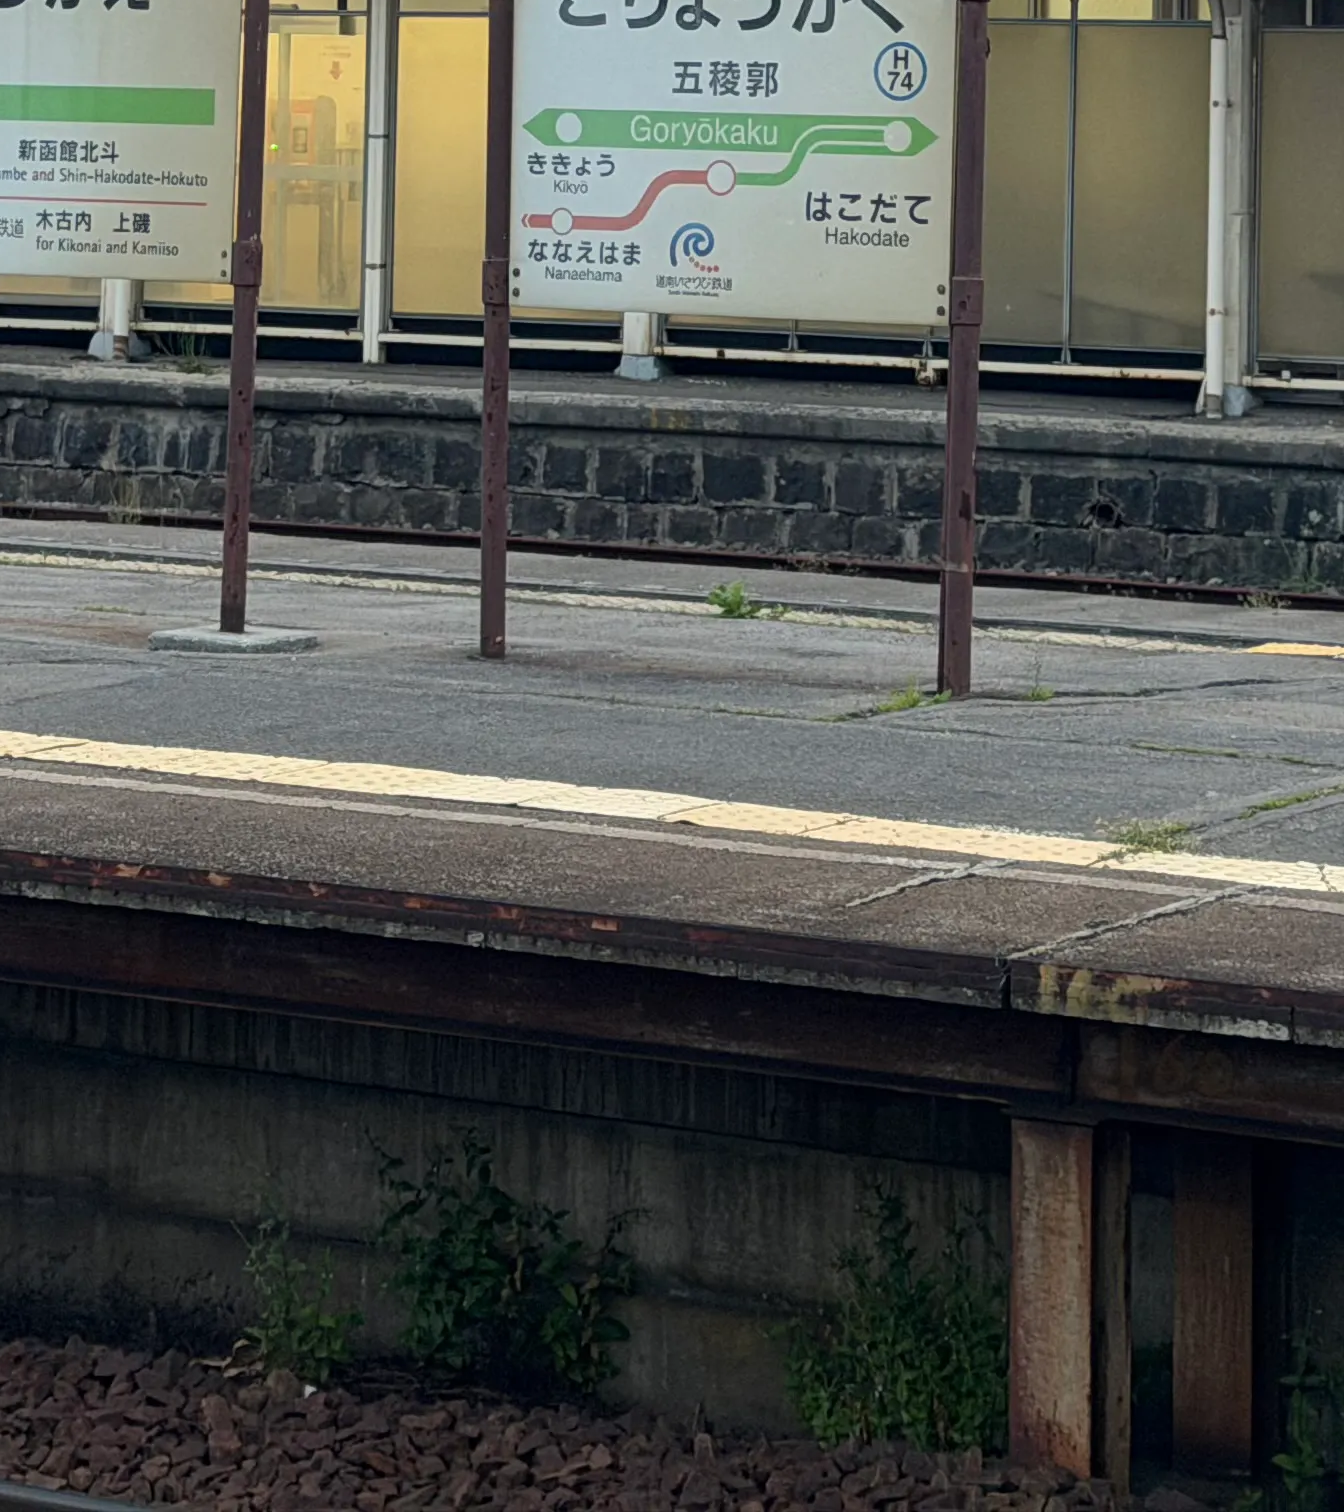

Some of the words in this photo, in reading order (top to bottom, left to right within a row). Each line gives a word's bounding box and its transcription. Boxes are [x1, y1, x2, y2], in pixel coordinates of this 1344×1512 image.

[893, 49, 909, 70] H
[671, 60, 779, 98] 五稜郭
[886, 71, 914, 93] 74
[629, 114, 779, 147] Goryōkaku
[18, 139, 120, 165] 新函館北斗
[526, 151, 616, 177] ききょう
[31, 167, 55, 182] and
[59, 167, 209, 187] Shin-Hakodate-Hokuto
[553, 179, 589, 195] Kikyō
[805, 191, 932, 225] はこだて
[35, 209, 92, 233] 木古内
[112, 211, 151, 234] 上磯
[35, 235, 55, 251] for
[57, 238, 102, 253] Kikonai
[105, 240, 128, 254] and
[132, 240, 179, 257] Kamiiso
[825, 226, 910, 248] Hakodate
[527, 238, 641, 267] ななえはま
[544, 265, 623, 283] Nanaehama
